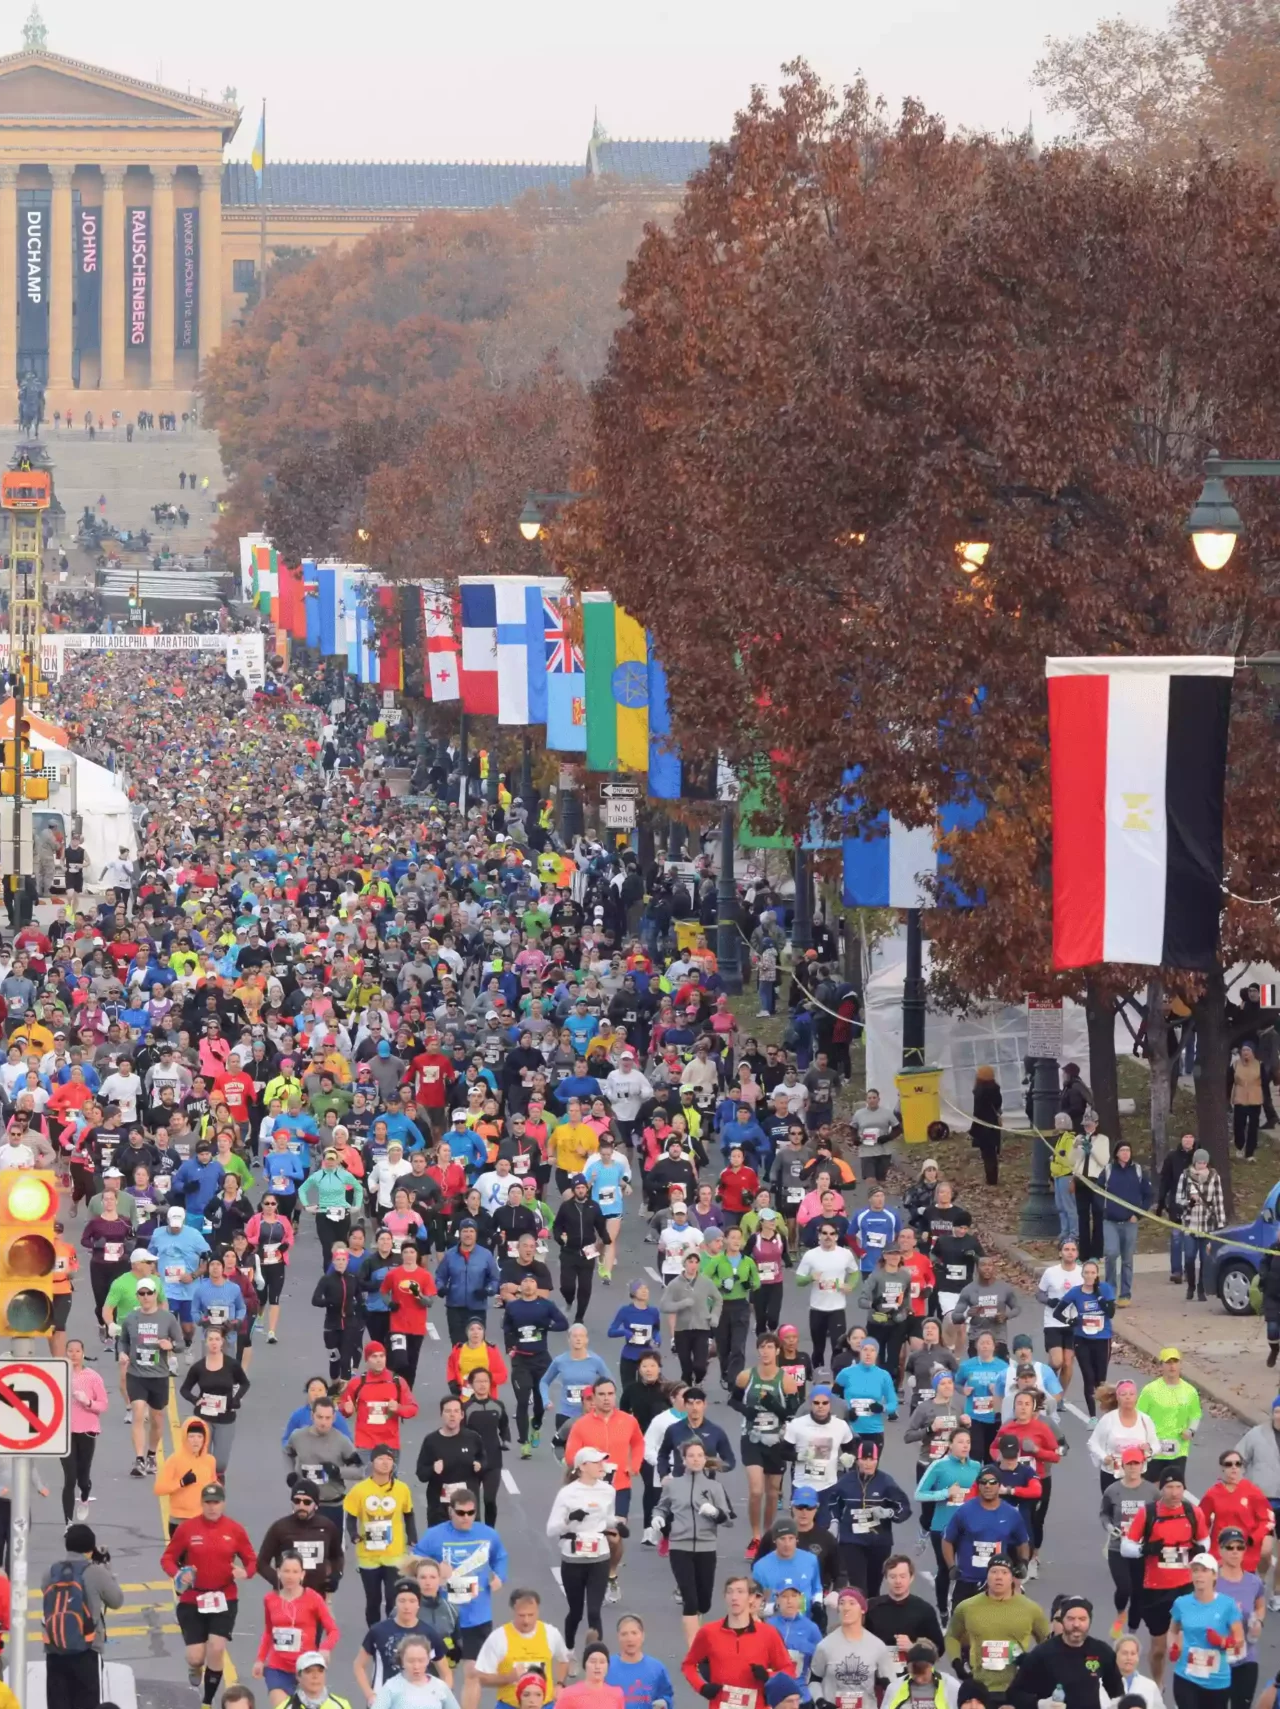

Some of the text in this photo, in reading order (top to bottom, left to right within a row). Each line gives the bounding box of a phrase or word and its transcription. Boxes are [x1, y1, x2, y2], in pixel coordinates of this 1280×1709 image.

[27, 211, 41, 304] DUCHAMP
[81, 212, 97, 273] JOHNS
[131, 210, 146, 344] RAUSCHENBERG
[90, 635, 148, 648] PHILADELPHIA
[153, 635, 200, 648] MARATHON
[608, 815, 633, 823] TURNS
[614, 804, 627, 812] NO
